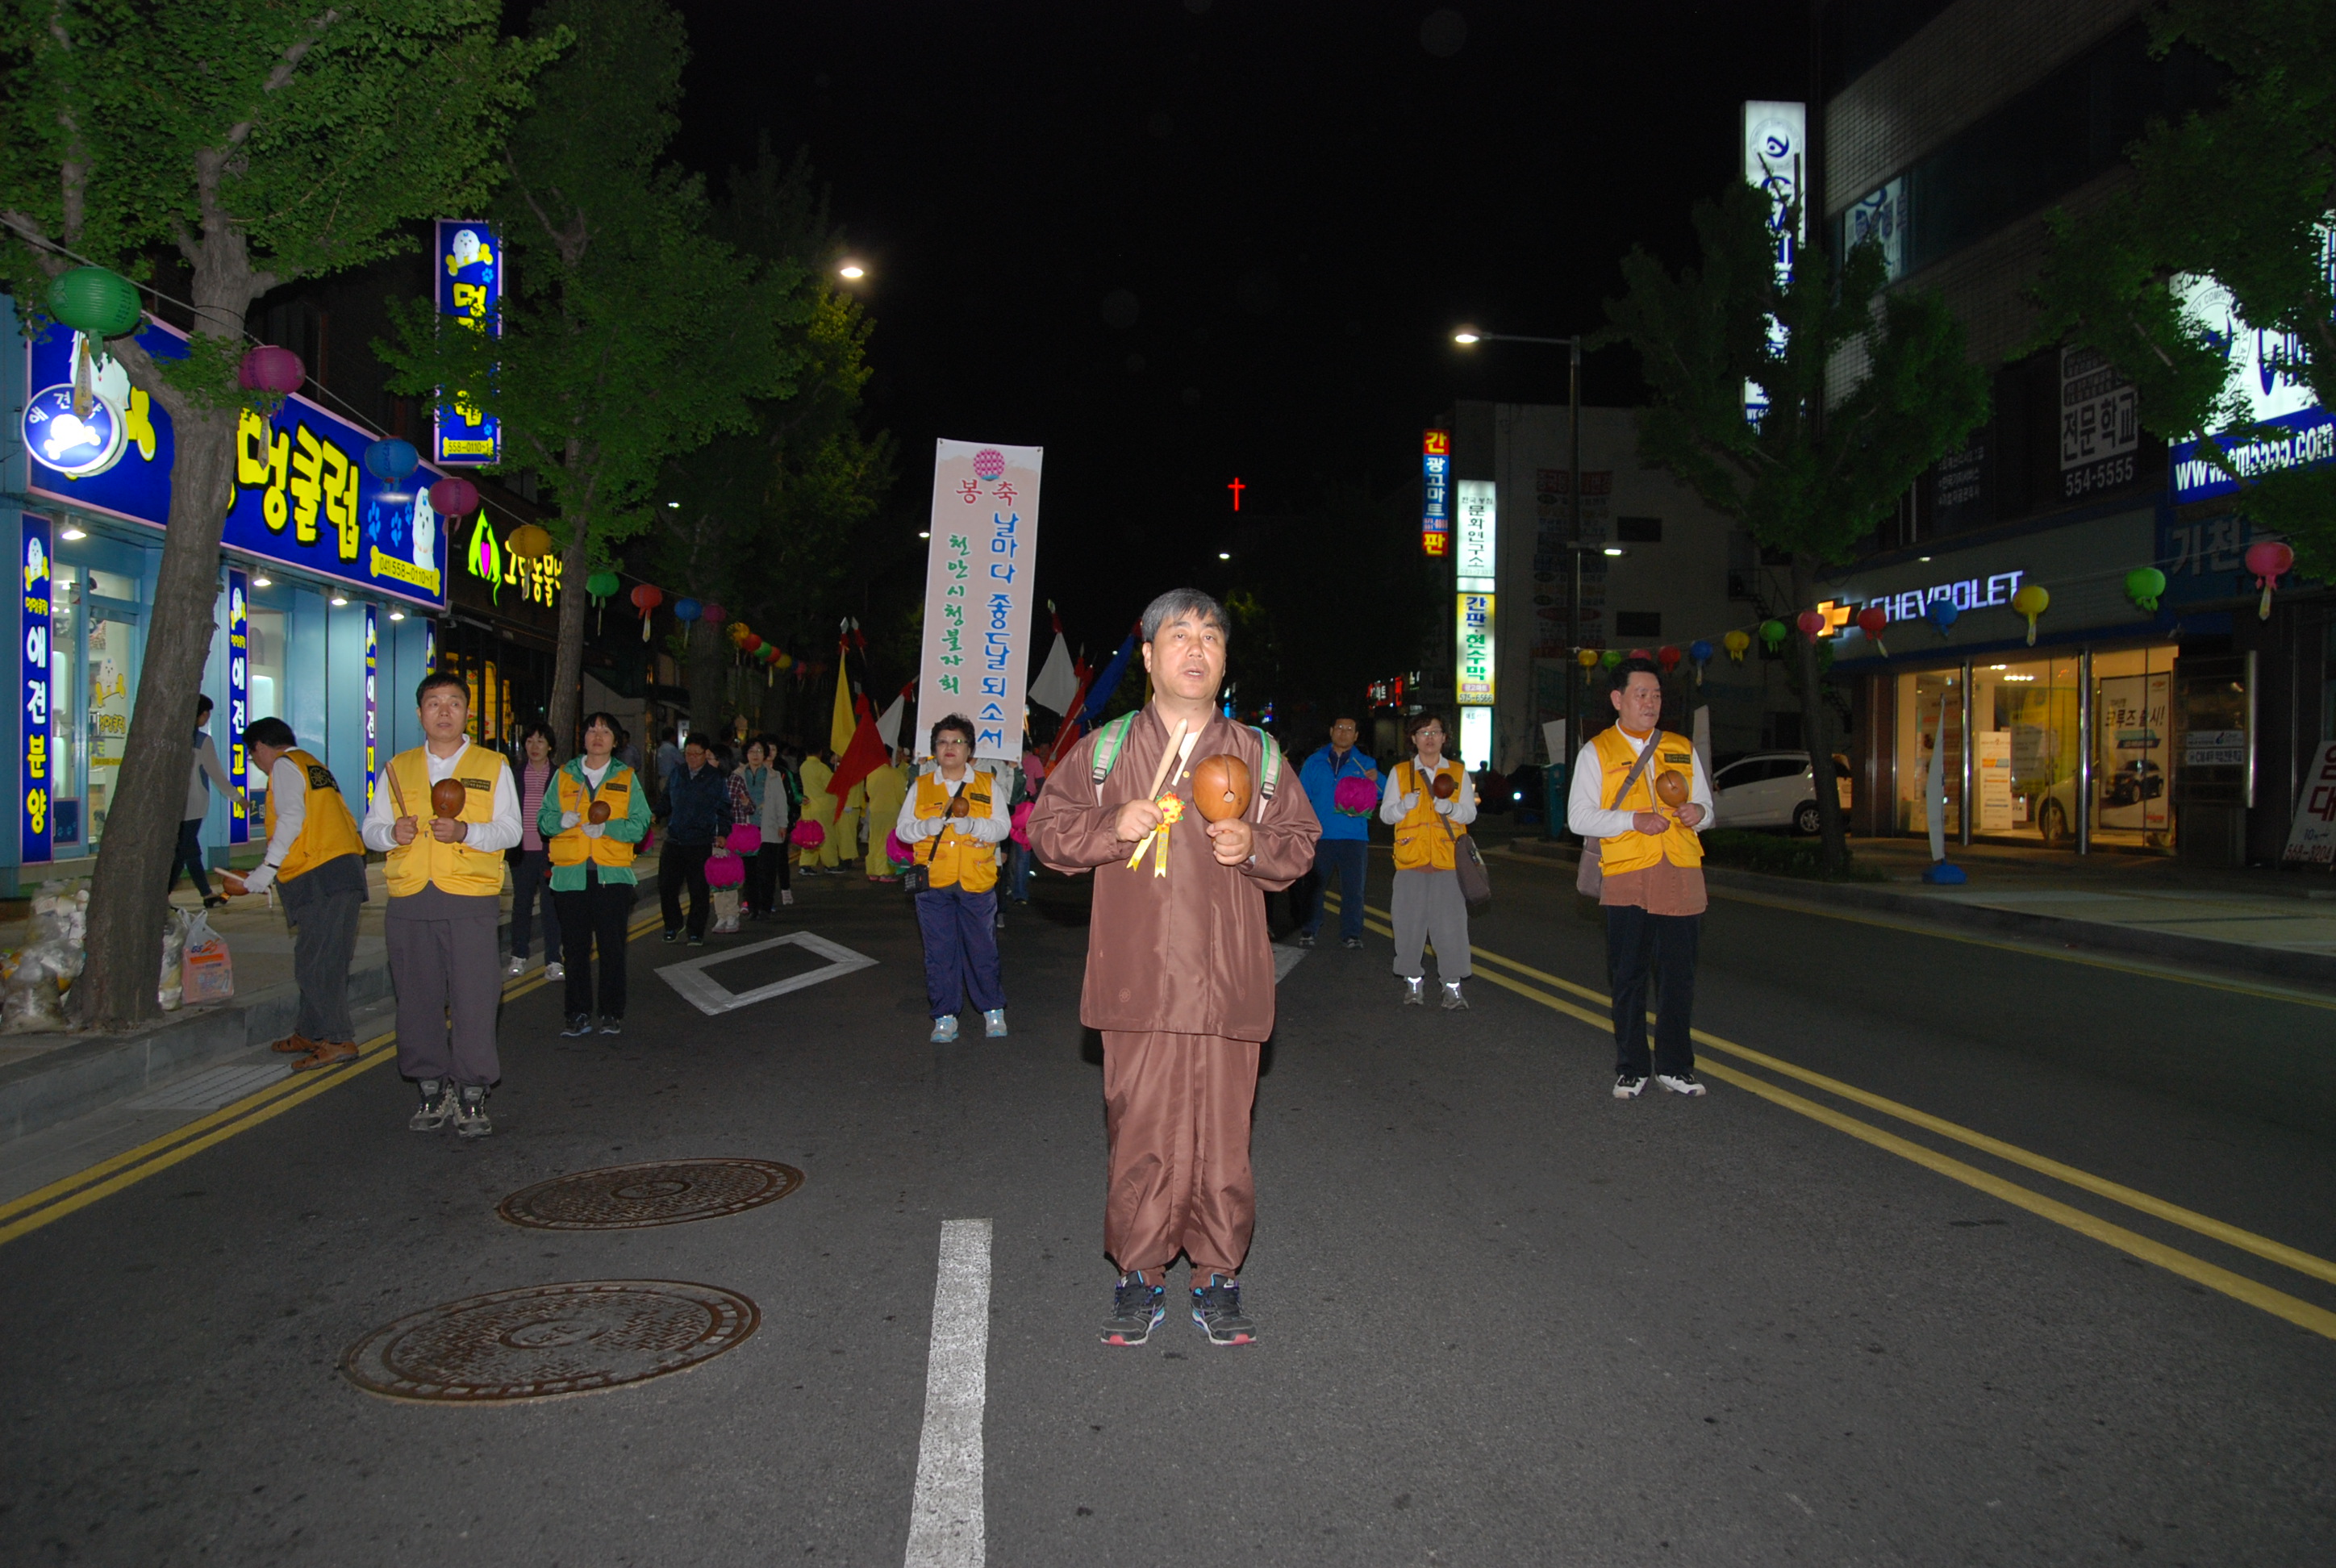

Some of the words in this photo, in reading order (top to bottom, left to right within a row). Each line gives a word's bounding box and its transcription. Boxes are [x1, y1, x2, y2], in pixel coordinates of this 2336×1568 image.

[1425, 432, 1447, 453] 간
[2063, 392, 2135, 461] 전문학교
[227, 407, 360, 559] 멍클럽
[1426, 457, 1445, 516] 광고마트
[2065, 457, 2134, 497] 554-5555
[990, 512, 1020, 585] 날마다
[1425, 534, 1445, 555] 판
[1468, 505, 1485, 568] 문화연구소
[938, 535, 970, 694] 천안시청불자회
[1871, 570, 2024, 623] HEVOLET
[27, 626, 48, 835] 애견분양
